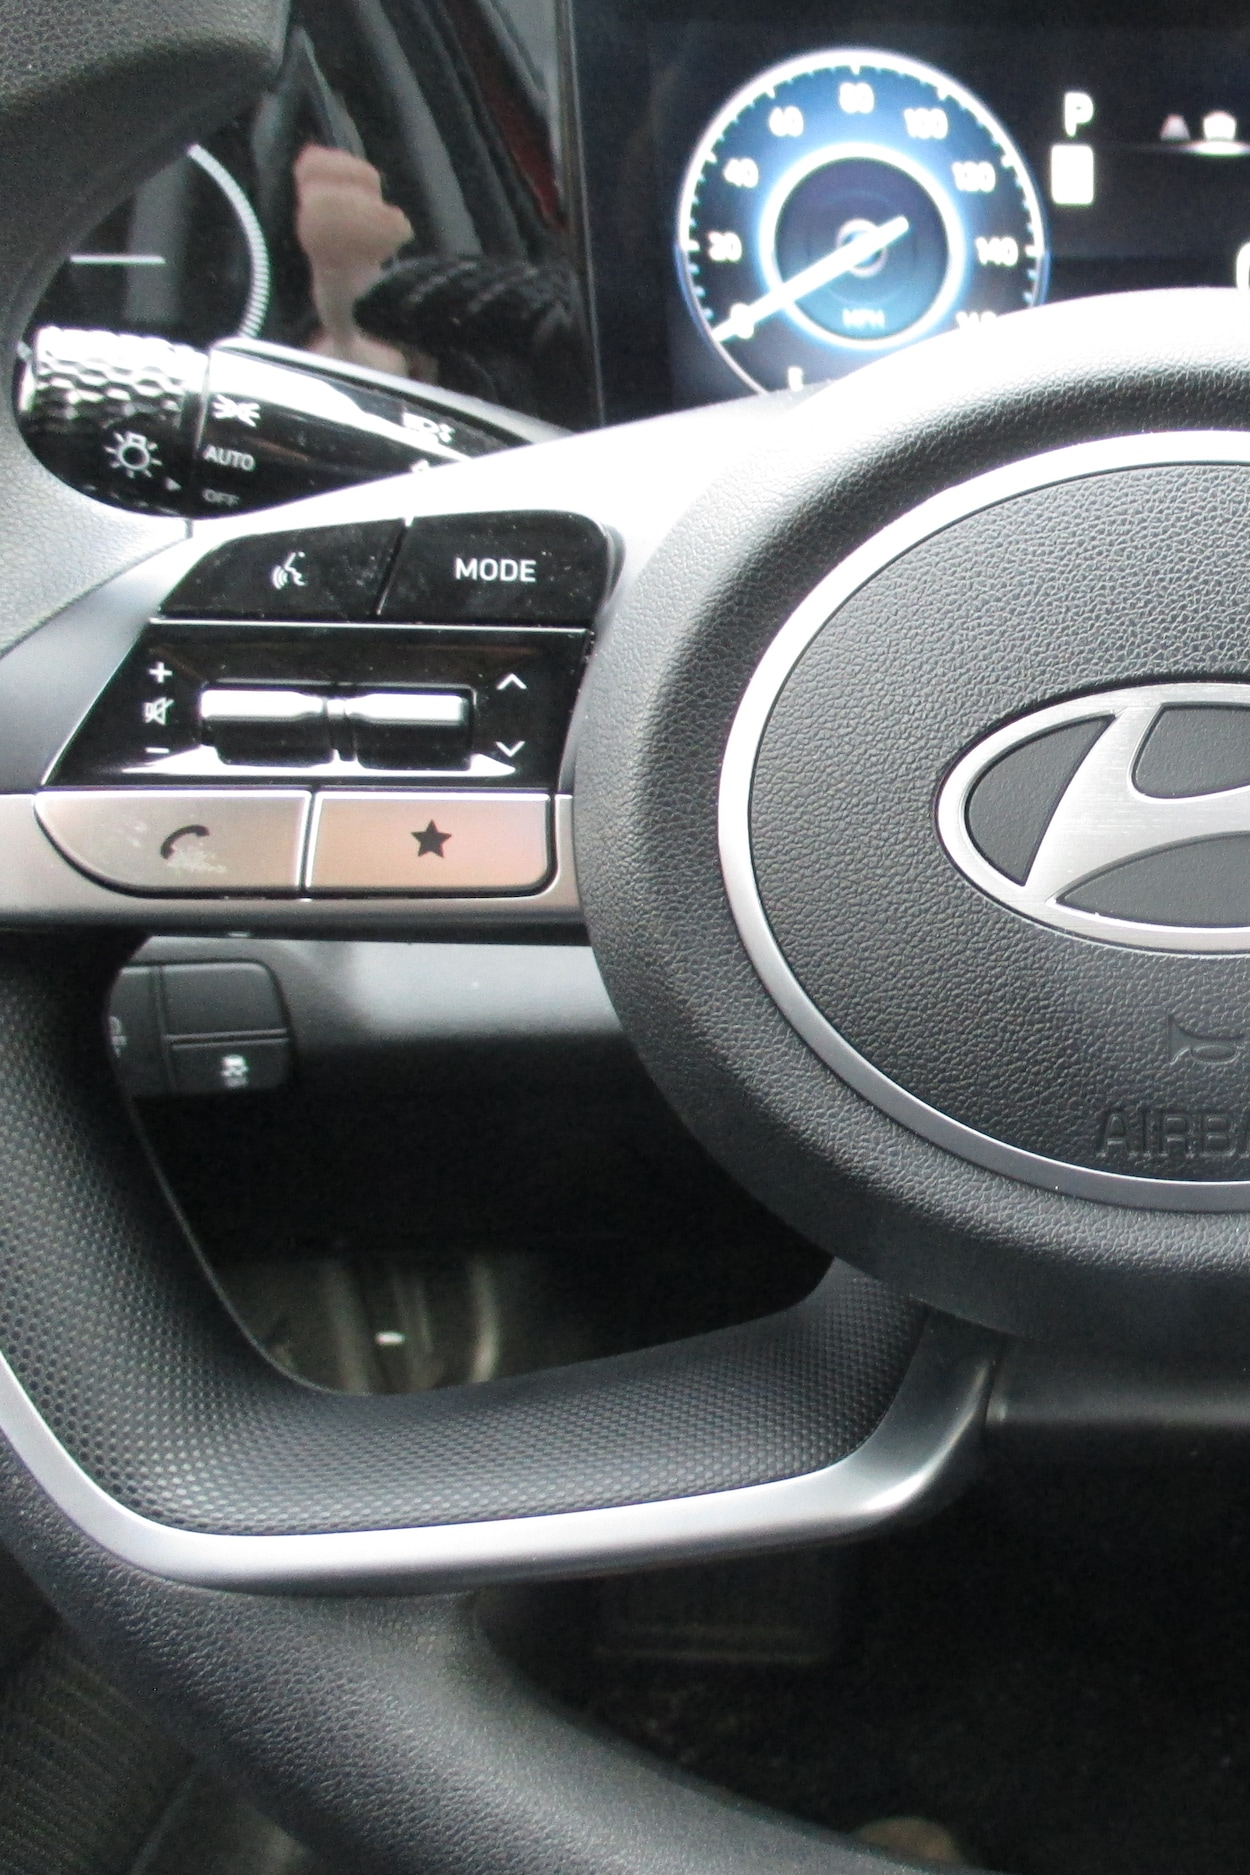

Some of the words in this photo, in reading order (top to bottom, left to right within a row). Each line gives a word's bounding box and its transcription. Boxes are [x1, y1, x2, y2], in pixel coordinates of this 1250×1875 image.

[839, 82, 875, 114] 80
[1063, 91, 1095, 137] P
[769, 106, 804, 138] 60
[903, 107, 949, 140] 100
[723, 157, 759, 189] 40
[975, 237, 1019, 267] 140
[842, 309, 886, 330] MPH
[202, 444, 256, 472] AUTO
[454, 556, 538, 583] MODE
